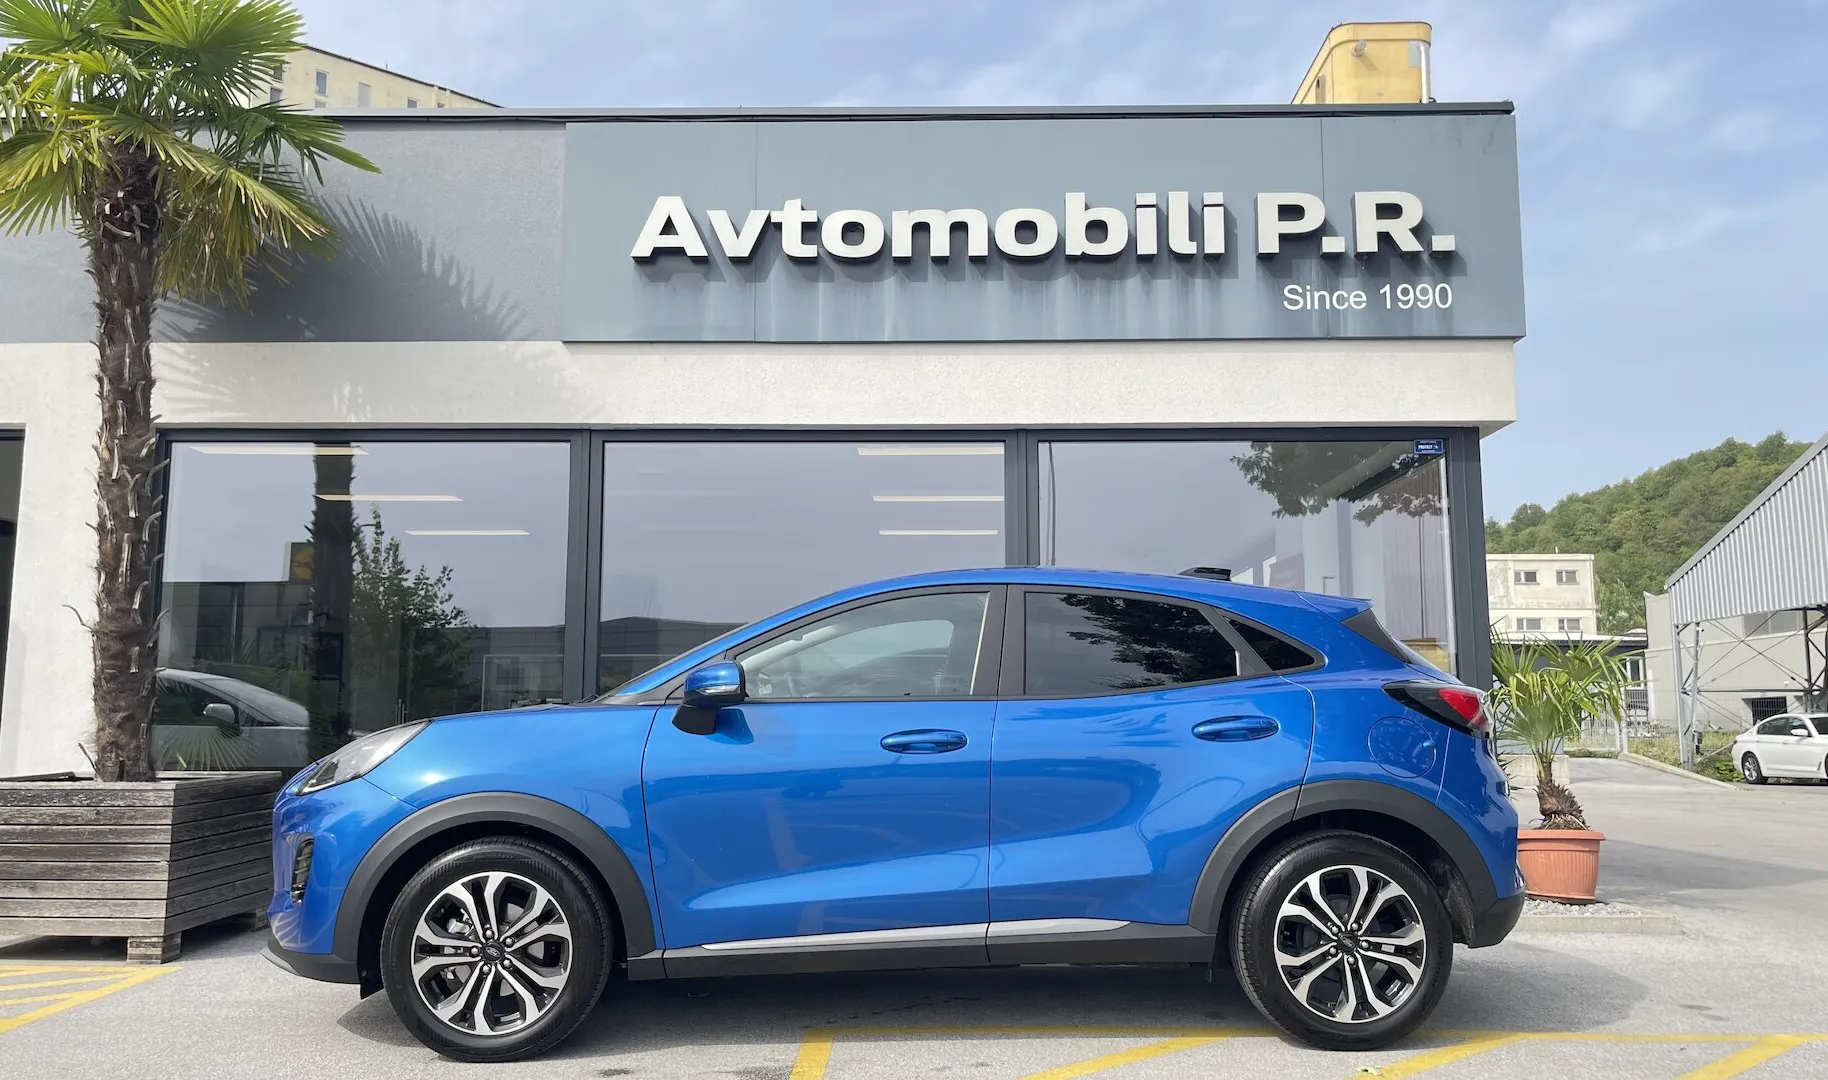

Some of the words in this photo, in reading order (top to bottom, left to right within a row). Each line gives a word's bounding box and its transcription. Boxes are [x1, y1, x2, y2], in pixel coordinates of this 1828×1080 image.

[629, 191, 1225, 259] Avtomobili
[1256, 190, 1457, 254] P.R.
[1282, 283, 1367, 311] Since
[1379, 282, 1454, 310] 1990
